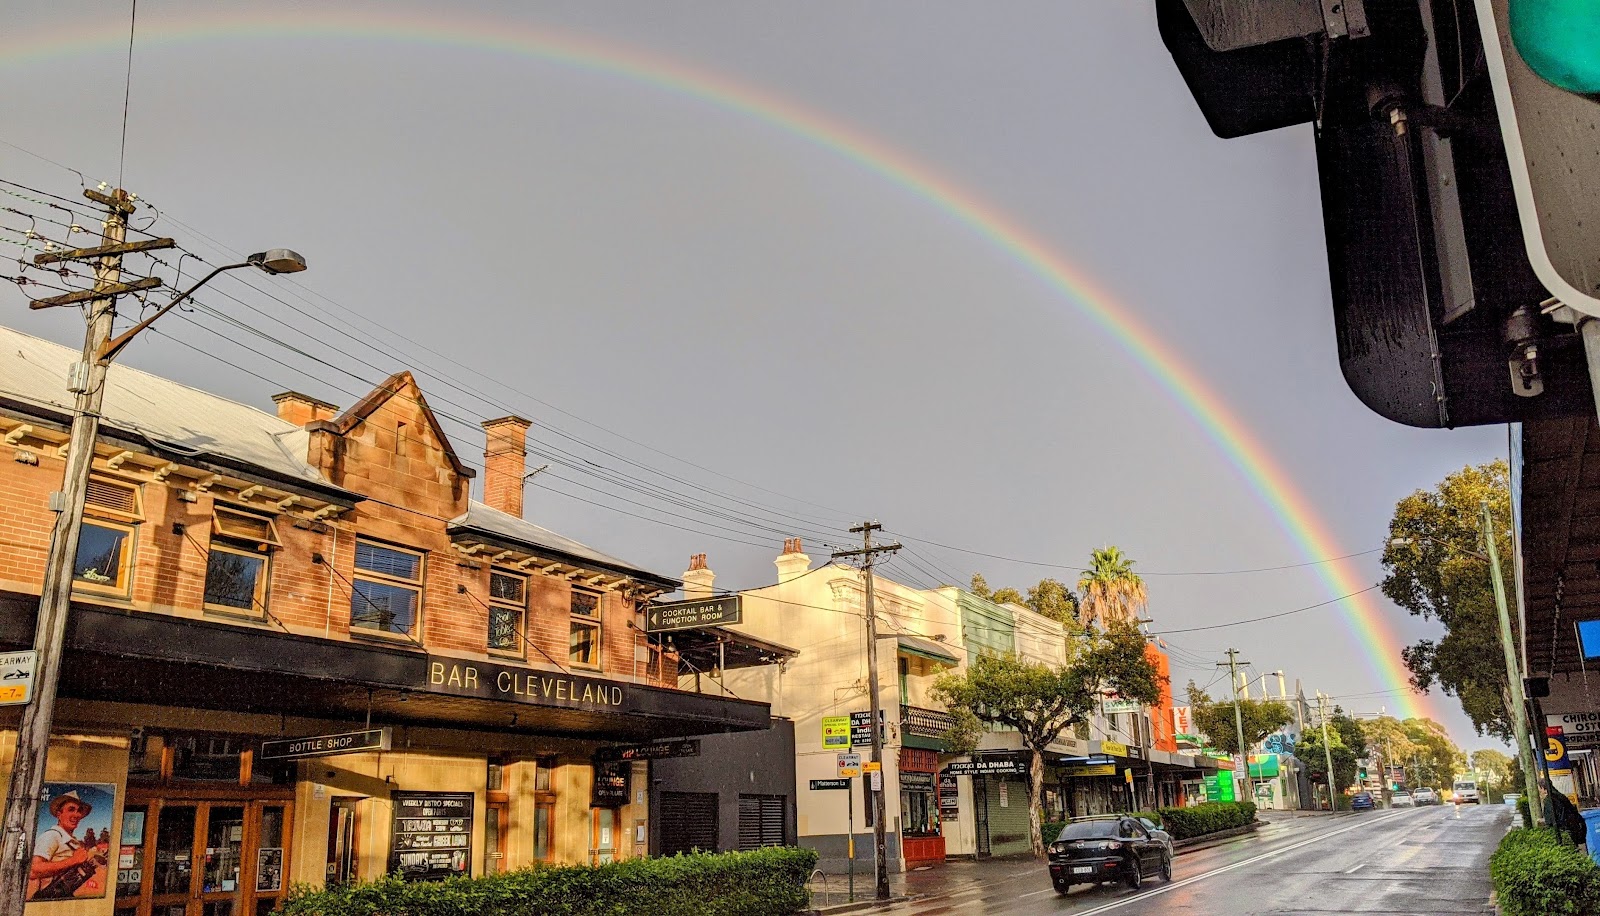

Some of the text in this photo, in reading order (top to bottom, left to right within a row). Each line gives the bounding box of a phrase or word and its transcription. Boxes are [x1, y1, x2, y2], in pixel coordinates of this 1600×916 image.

[662, 607, 697, 618] COCKTAIL
[699, 605, 714, 613] BAR
[662, 612, 723, 625] FUNCTION ROOM
[430, 662, 622, 706] BAR CLEVELAND
[1177, 707, 1188, 734] VET
[289, 737, 352, 752] BOTTLE SHOP
[622, 745, 670, 758] VIP LOUNGE
[951, 763, 974, 771] maya
[597, 776, 625, 787] LOUNGE
[402, 799, 424, 807] WEEKLY
[422, 808, 433, 816] OPEN
[402, 820, 432, 831] TRIVIA
